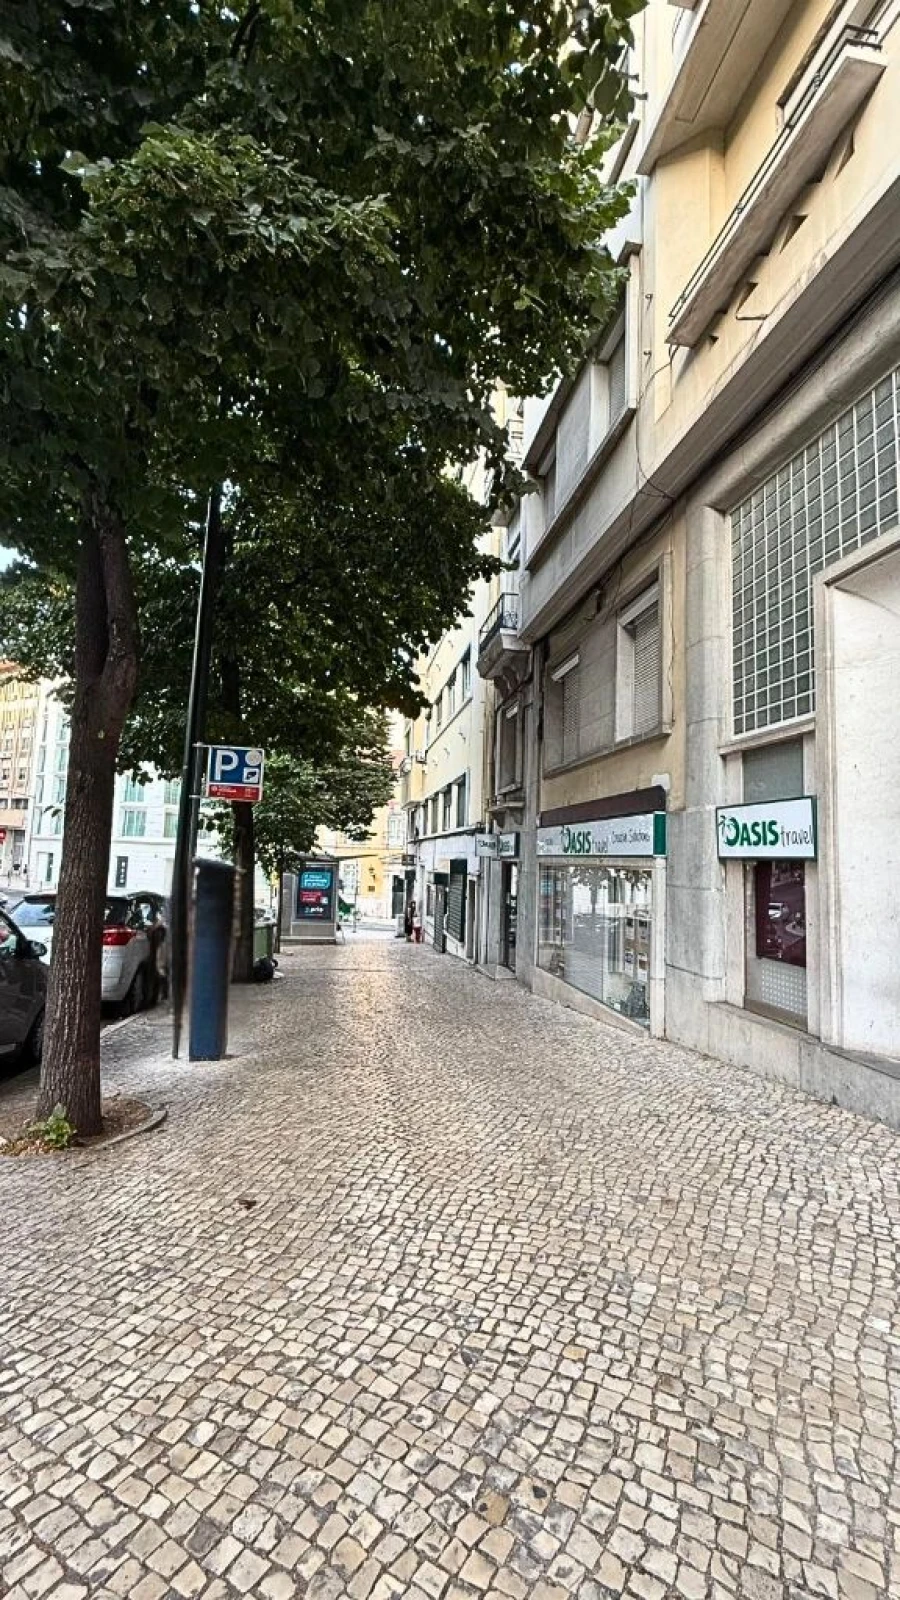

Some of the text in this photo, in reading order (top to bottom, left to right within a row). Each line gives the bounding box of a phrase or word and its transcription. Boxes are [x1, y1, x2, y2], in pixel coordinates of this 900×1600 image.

[214, 750, 239, 781] P
[561, 825, 592, 853] OASIS
[718, 815, 814, 847] OASIS travel
